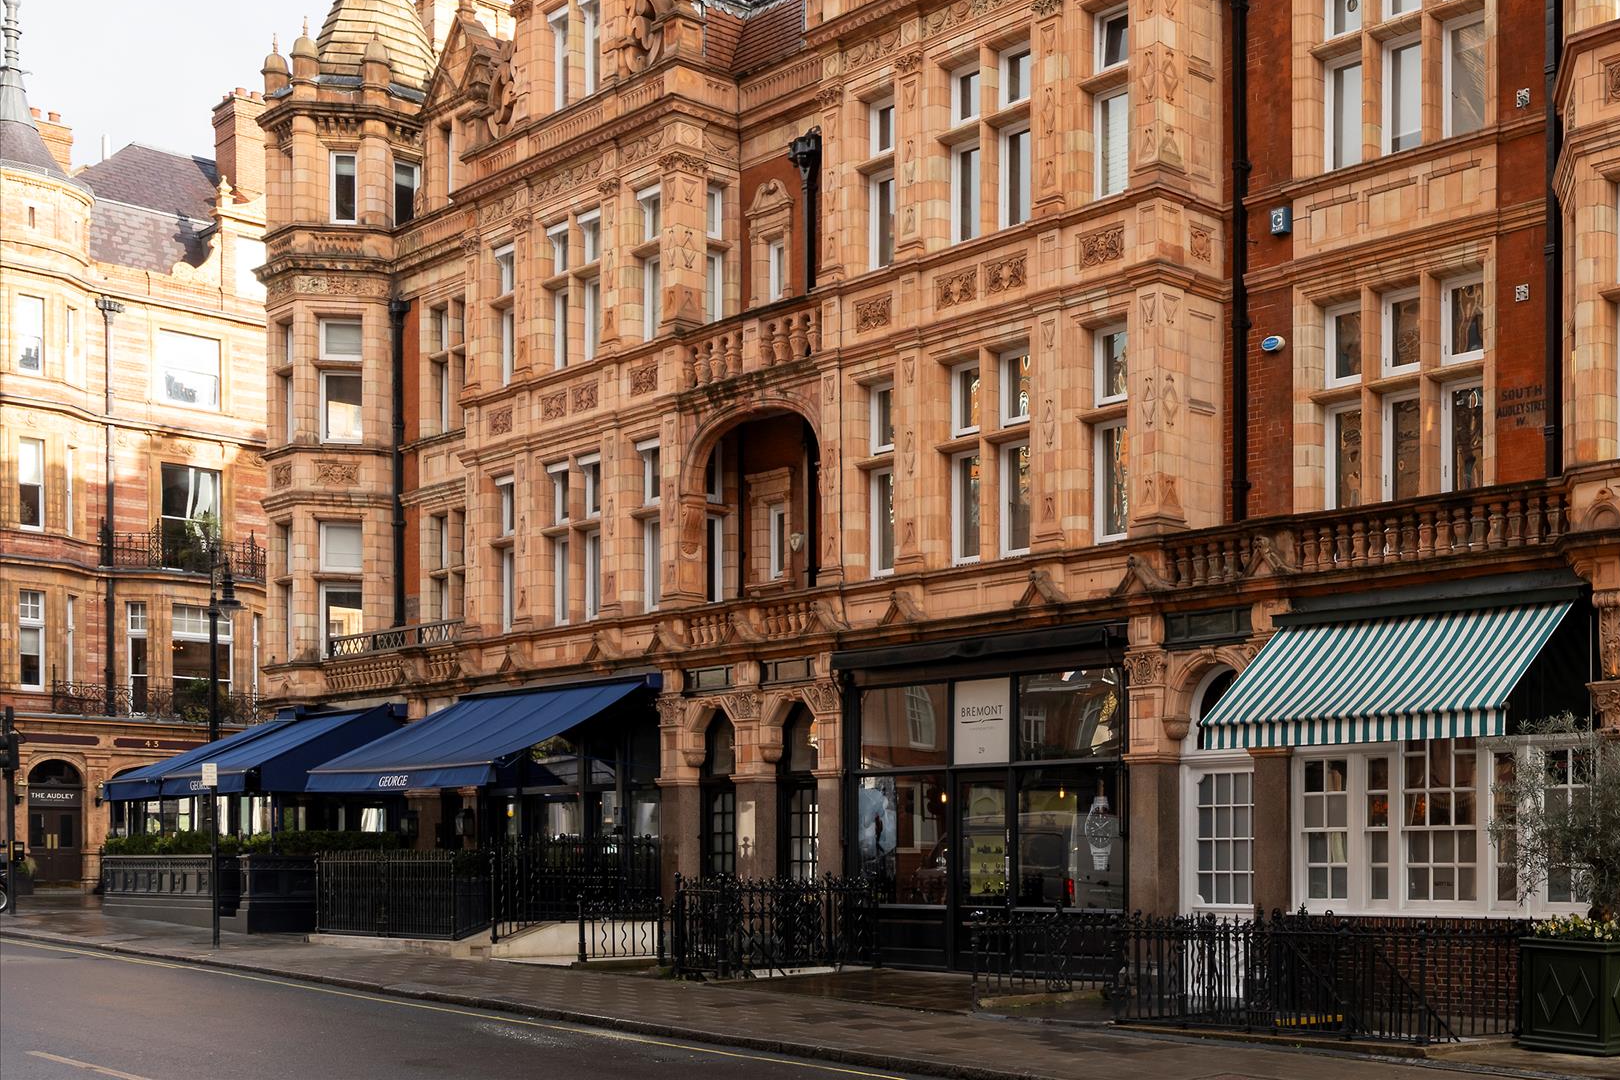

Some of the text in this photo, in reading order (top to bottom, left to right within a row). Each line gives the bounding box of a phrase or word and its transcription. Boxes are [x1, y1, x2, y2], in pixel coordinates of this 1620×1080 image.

[1501, 384, 1543, 400] SOUTH
[1496, 403, 1526, 419] AUDLEY
[961, 705, 1003, 718] BREMONT
[145, 740, 159, 748] 43
[378, 775, 408, 787] GEORGE
[47, 792, 74, 800] AUDLEY
